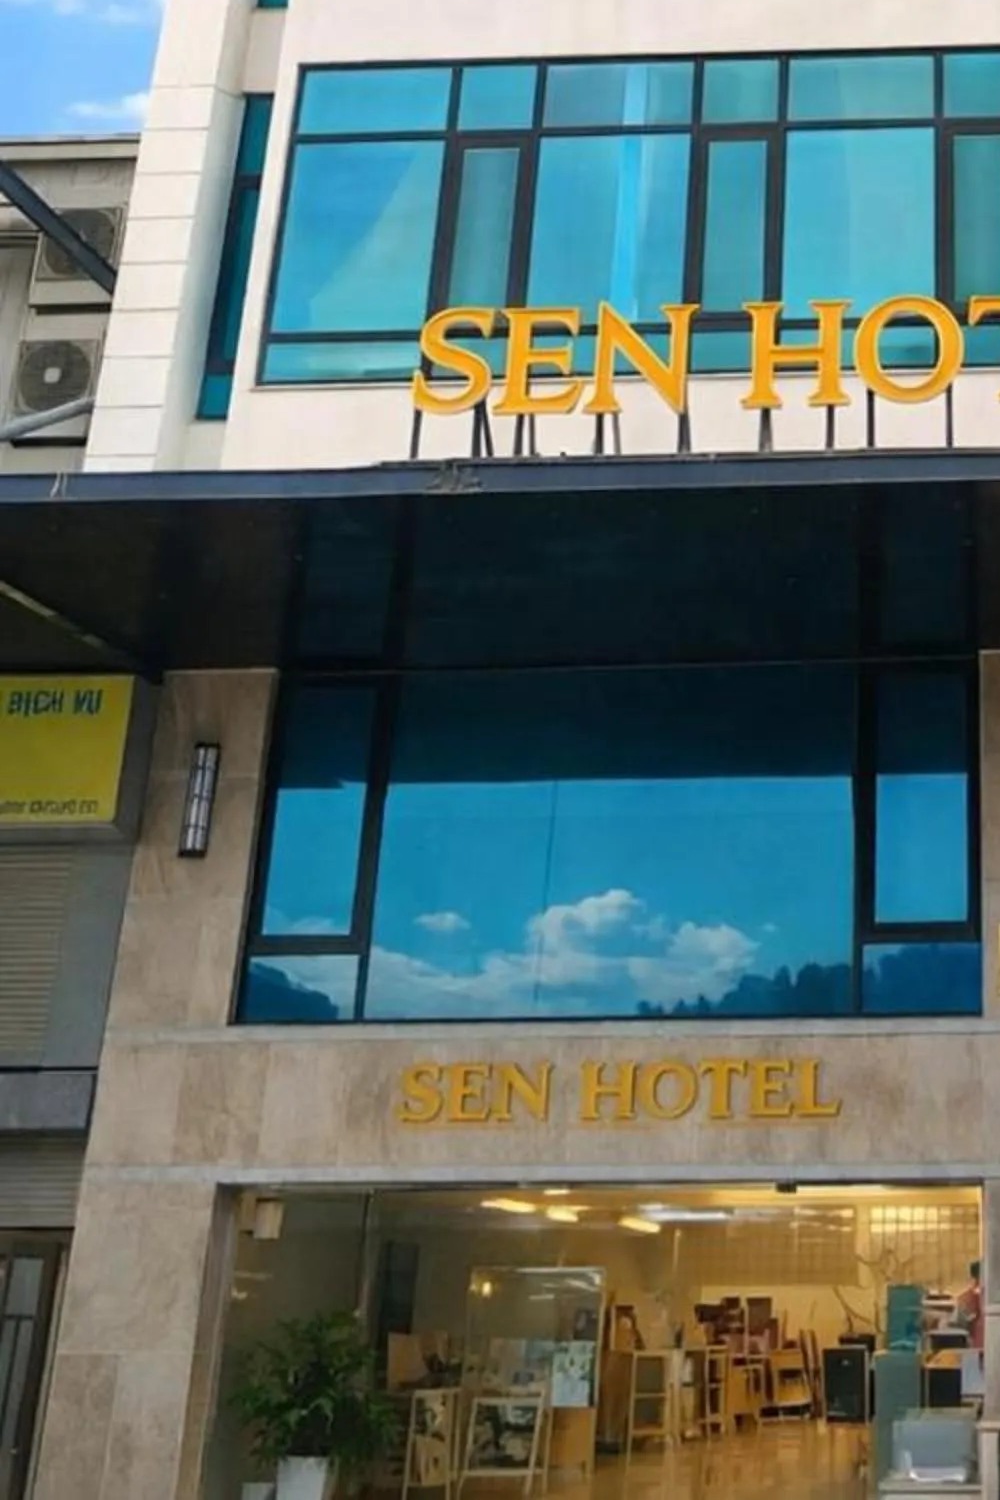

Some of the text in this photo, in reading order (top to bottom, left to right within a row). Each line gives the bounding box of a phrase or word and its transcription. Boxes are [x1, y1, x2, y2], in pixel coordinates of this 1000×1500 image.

[412, 301, 700, 415] SEN
[398, 1056, 843, 1123] SEN HOTEL
